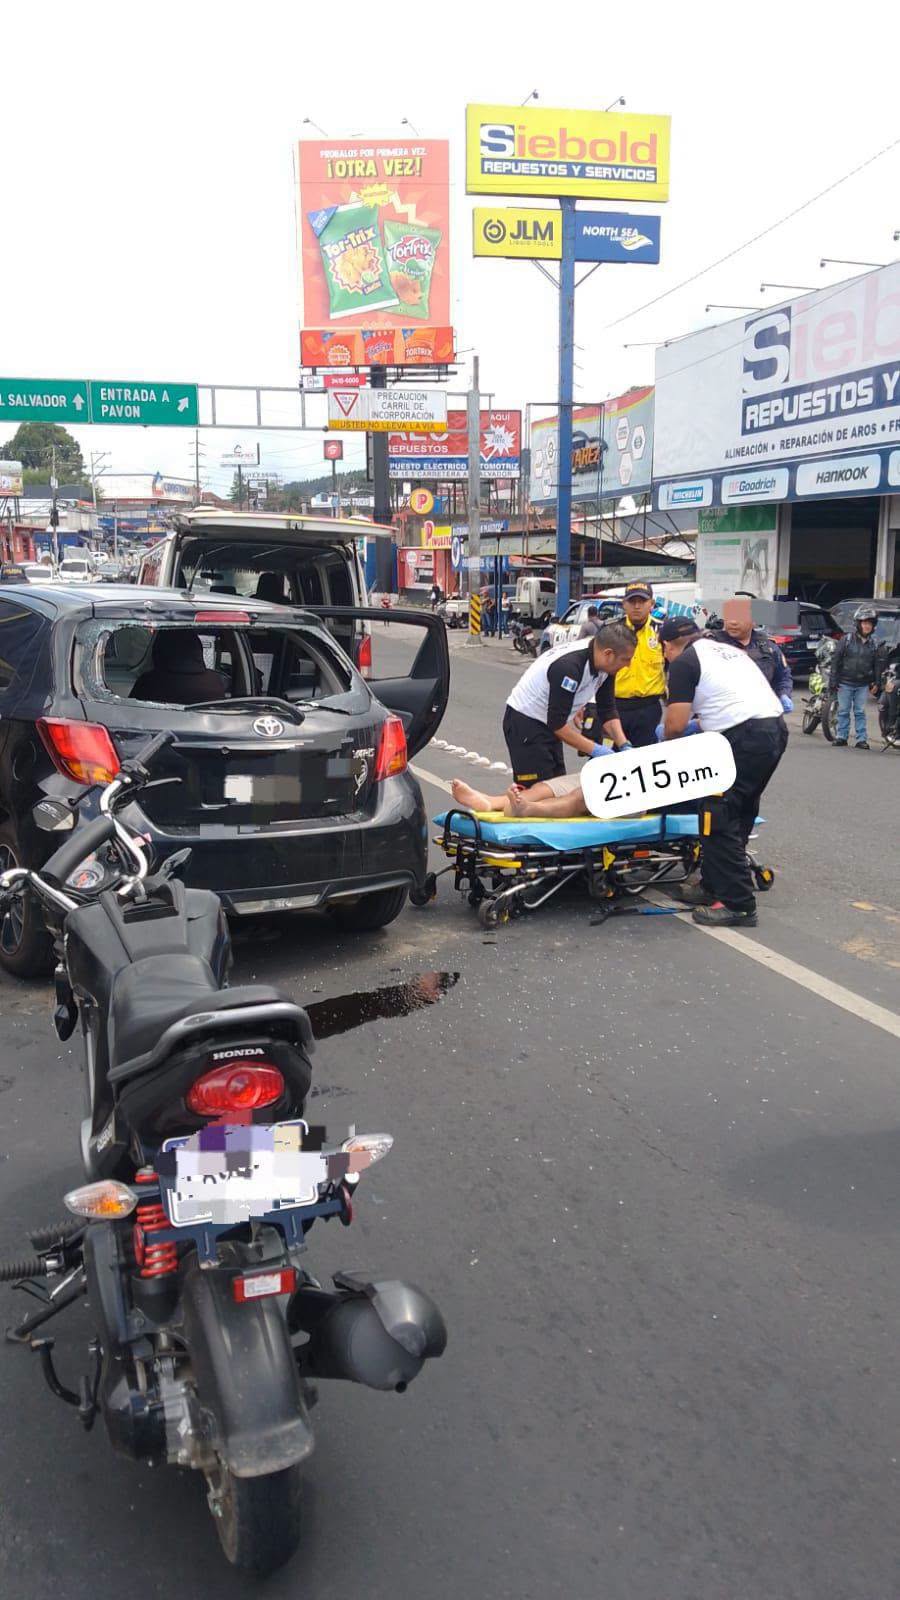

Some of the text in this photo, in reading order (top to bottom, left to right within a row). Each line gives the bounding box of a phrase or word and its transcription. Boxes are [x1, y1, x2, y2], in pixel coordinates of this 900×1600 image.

[480, 123, 658, 164] Siebold
[327, 157, 422, 178] ¡OTRA VEZ!
[484, 161, 656, 181] REPUESTOS Y SERVICIOS
[510, 220, 554, 241] JLM
[583, 226, 639, 237] NORTH SEA
[742, 277, 900, 394] Sieb
[8, 394, 67, 407] SALVADOR
[100, 388, 170, 402] ENTRADA A
[377, 392, 428, 400] PRECAUCION
[746, 370, 900, 429] REPUESTOS Y
[101, 405, 140, 418] PAVON
[382, 402, 410, 410] CARRIL
[340, 421, 368, 429] USTED
[382, 422, 407, 430] LLEVA
[725, 441, 768, 459] ALINEACIÓN
[780, 430, 833, 450] REPARACIÓN
[836, 428, 848, 440] DE
[850, 422, 877, 438] AROS
[480, 462, 519, 470] TOMOTRIZ
[213, 1048, 264, 1060] HONDA
